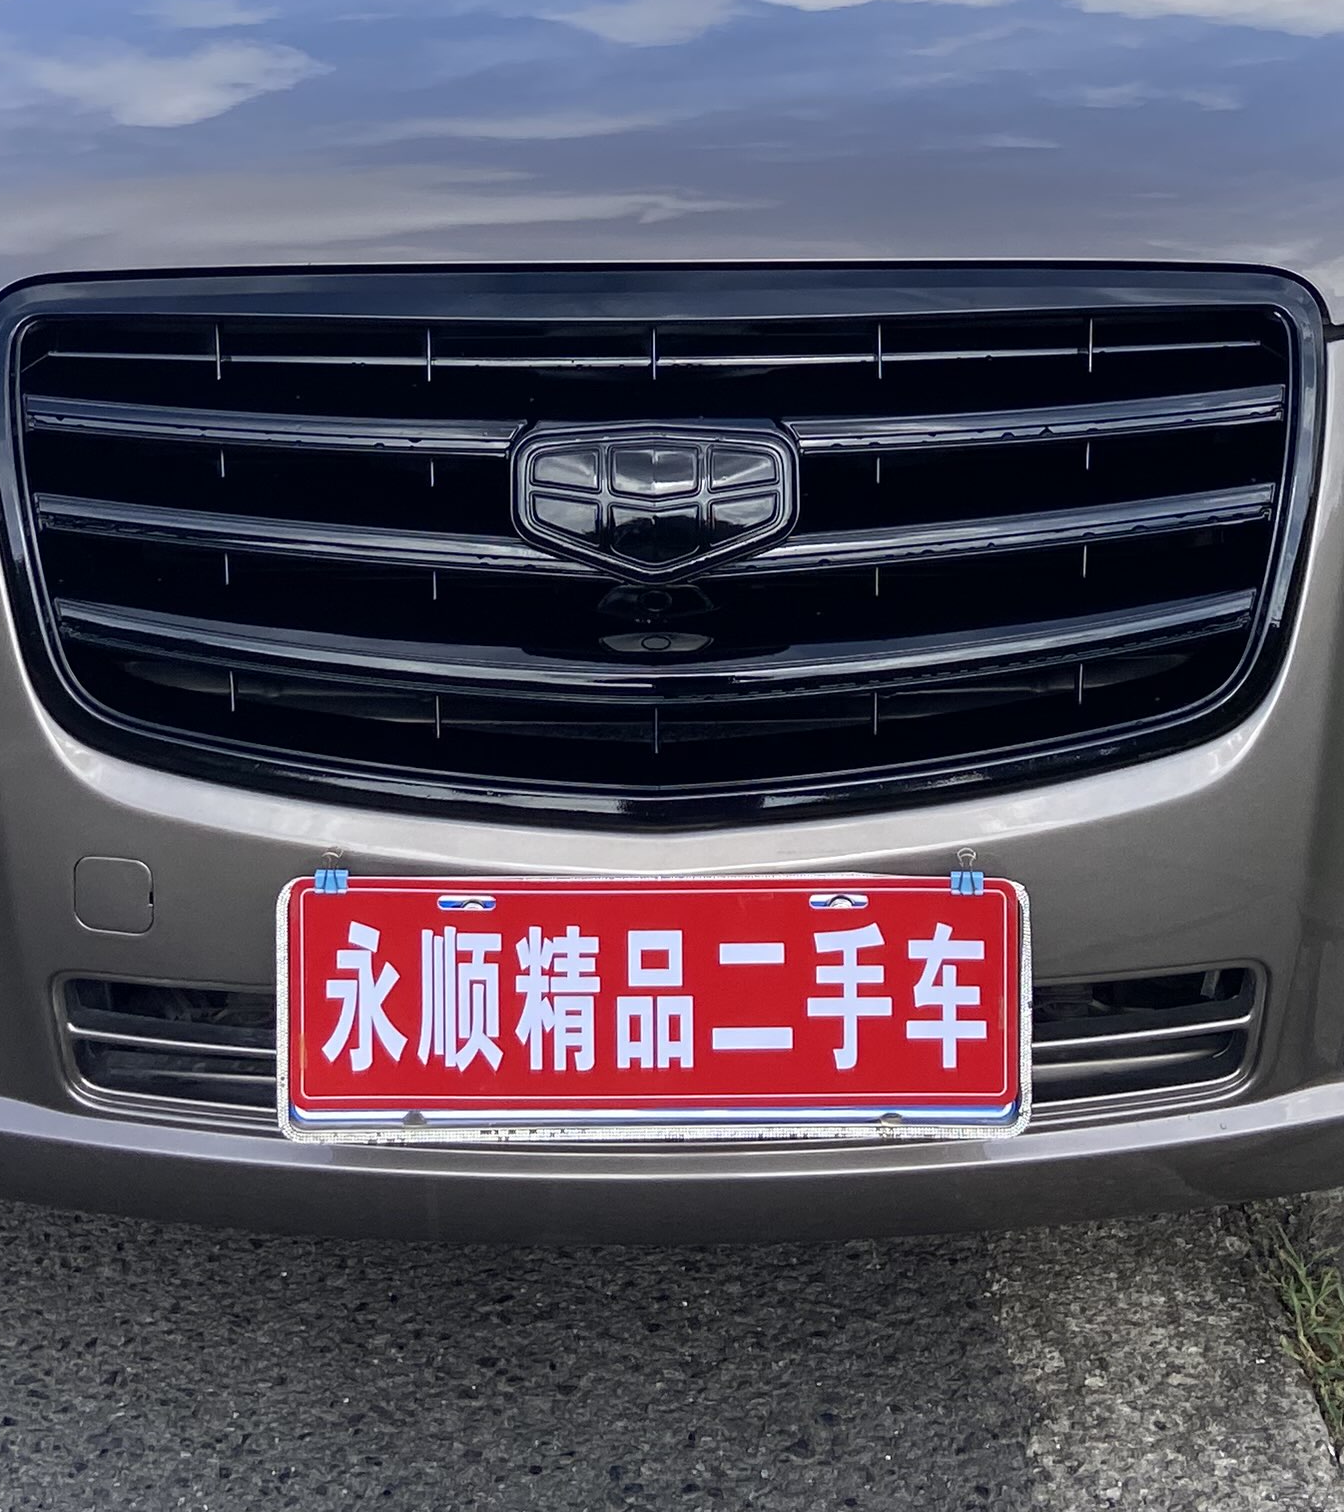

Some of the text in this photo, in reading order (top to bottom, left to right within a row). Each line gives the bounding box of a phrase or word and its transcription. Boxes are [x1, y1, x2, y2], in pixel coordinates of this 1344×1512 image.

[321, 921, 988, 1073] 永顺精品二手车
